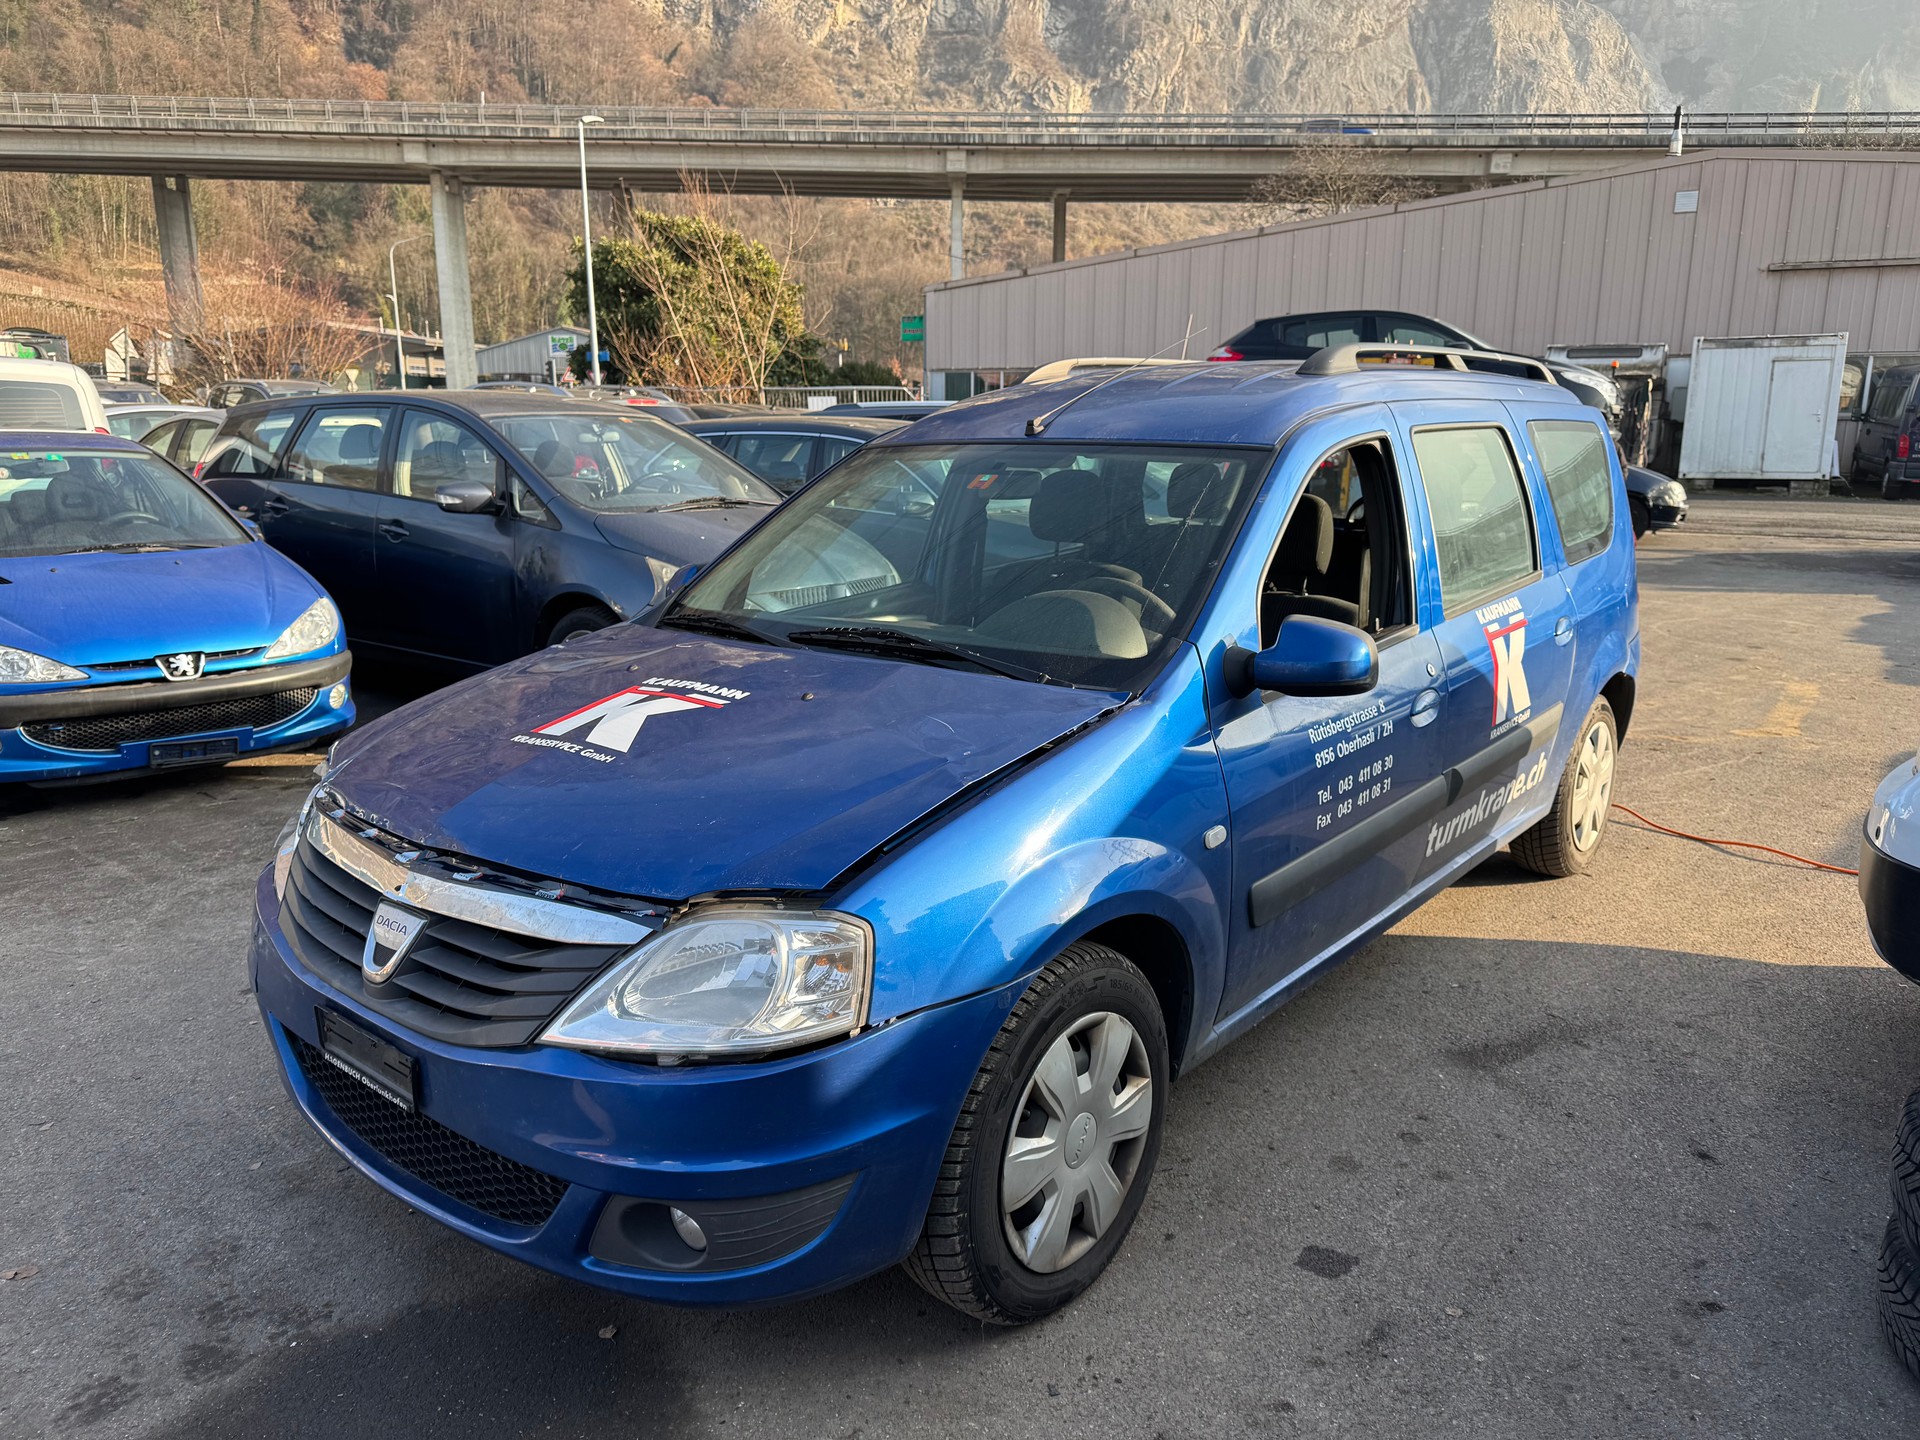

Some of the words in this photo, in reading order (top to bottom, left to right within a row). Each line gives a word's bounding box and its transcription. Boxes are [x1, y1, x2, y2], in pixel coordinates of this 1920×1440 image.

[1475, 596, 1522, 624] KAUFMANN
[642, 677, 750, 700] KAUFMANN
[1308, 705, 1380, 744] Rütisbergstrasse
[1378, 699, 1385, 713] 8
[1490, 713, 1519, 740] KRANSERVICE
[510, 734, 582, 753] KRANSERVICE
[580, 748, 616, 763] GmbH
[1315, 747, 1335, 768] 8156
[1337, 727, 1375, 758] Oberhasli
[1382, 720, 1394, 737] ZH
[1317, 785, 1333, 805] Tel.
[1338, 775, 1353, 795] 043
[1358, 766, 1371, 783] 411
[1372, 760, 1382, 776] 08
[1384, 754, 1394, 770] 30
[1316, 812, 1331, 831] Fax
[1337, 799, 1352, 818] 043
[1357, 789, 1370, 806] 411
[1371, 783, 1381, 799] 08
[1382, 777, 1391, 793] 31
[1425, 752, 1548, 858] turmkrane.ch
[376, 914, 407, 936] DACIA
[324, 1052, 360, 1080] HAGENBUCH
